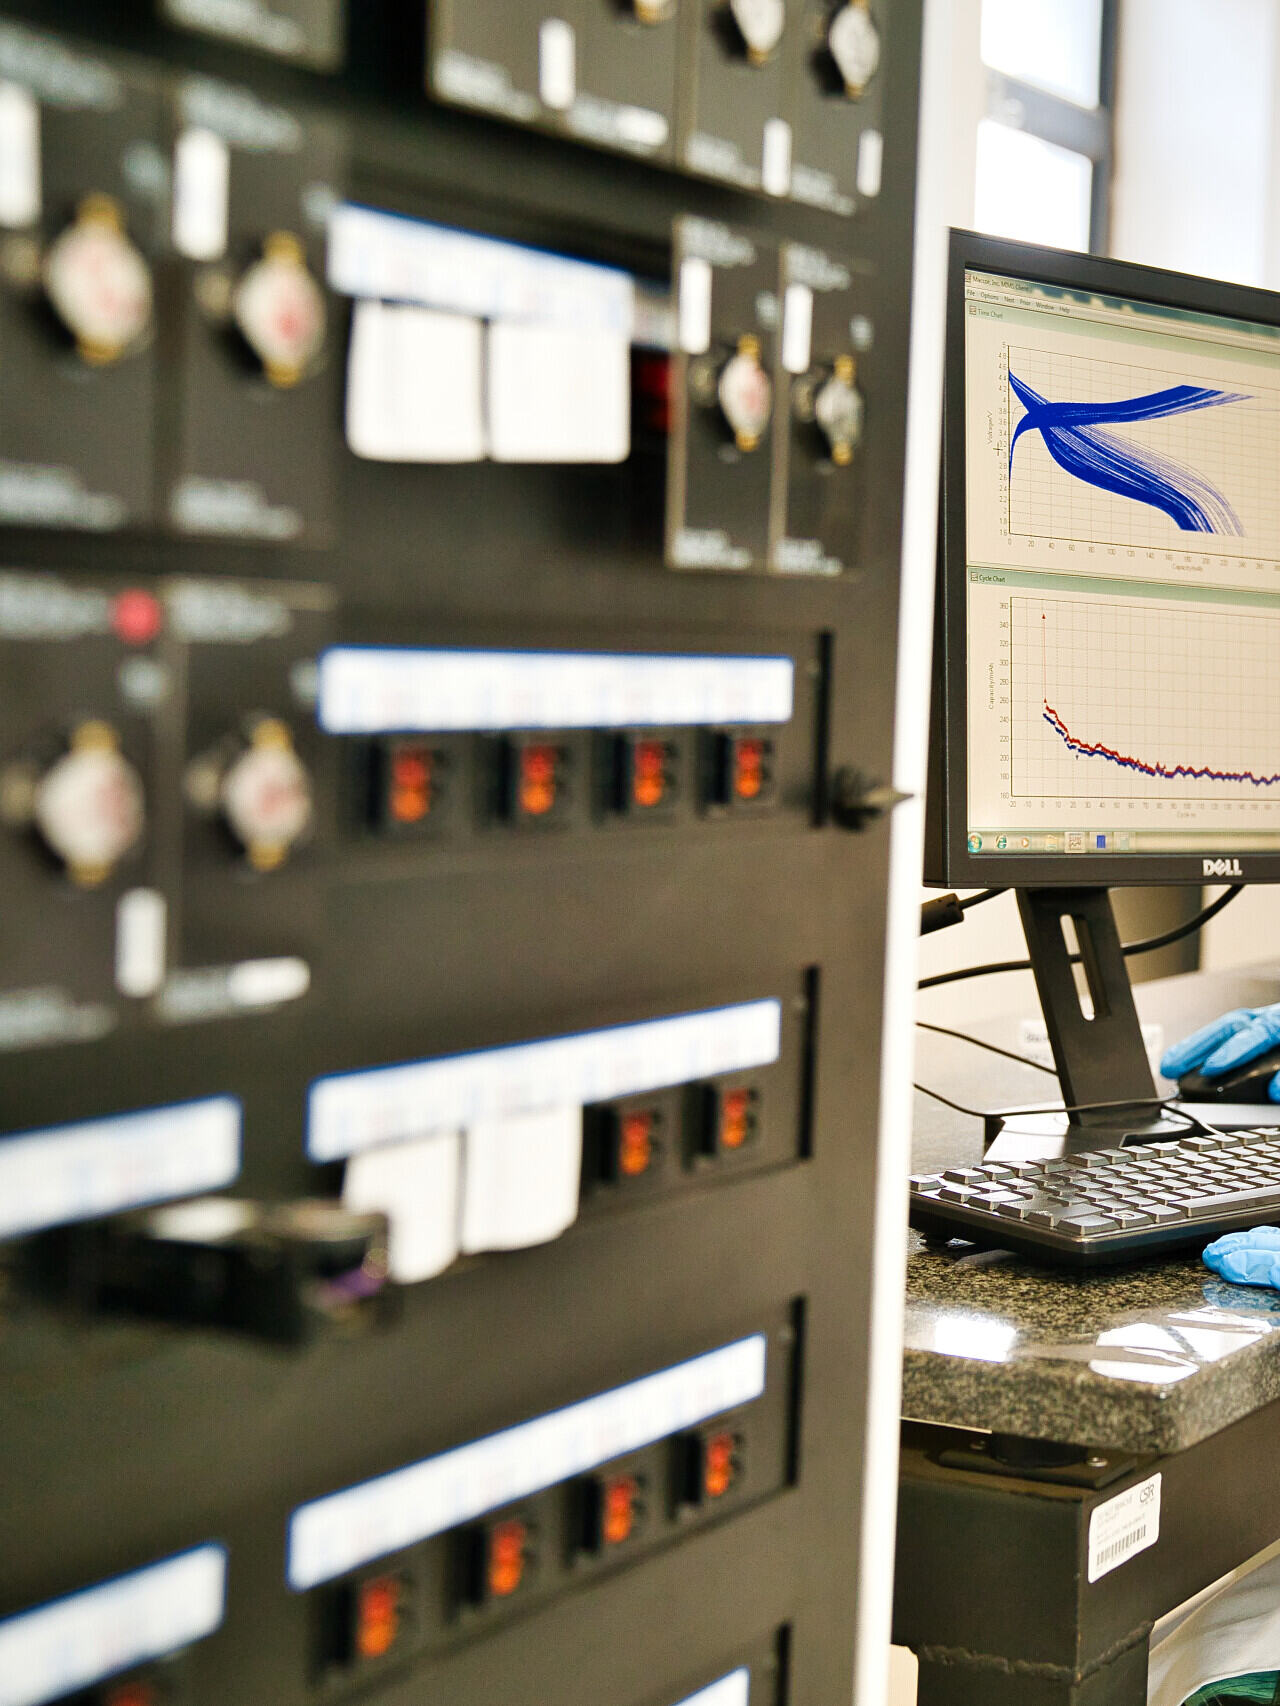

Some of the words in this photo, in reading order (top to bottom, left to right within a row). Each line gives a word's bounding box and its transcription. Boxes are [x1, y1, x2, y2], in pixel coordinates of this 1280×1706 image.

[980, 292, 999, 301] Options
[1035, 301, 1054, 310] Window
[1060, 306, 1071, 314] Help
[978, 308, 989, 316] Time
[979, 574, 992, 582] Cycle
[993, 575, 1005, 583] Chart
[1203, 859, 1242, 876] DELL
